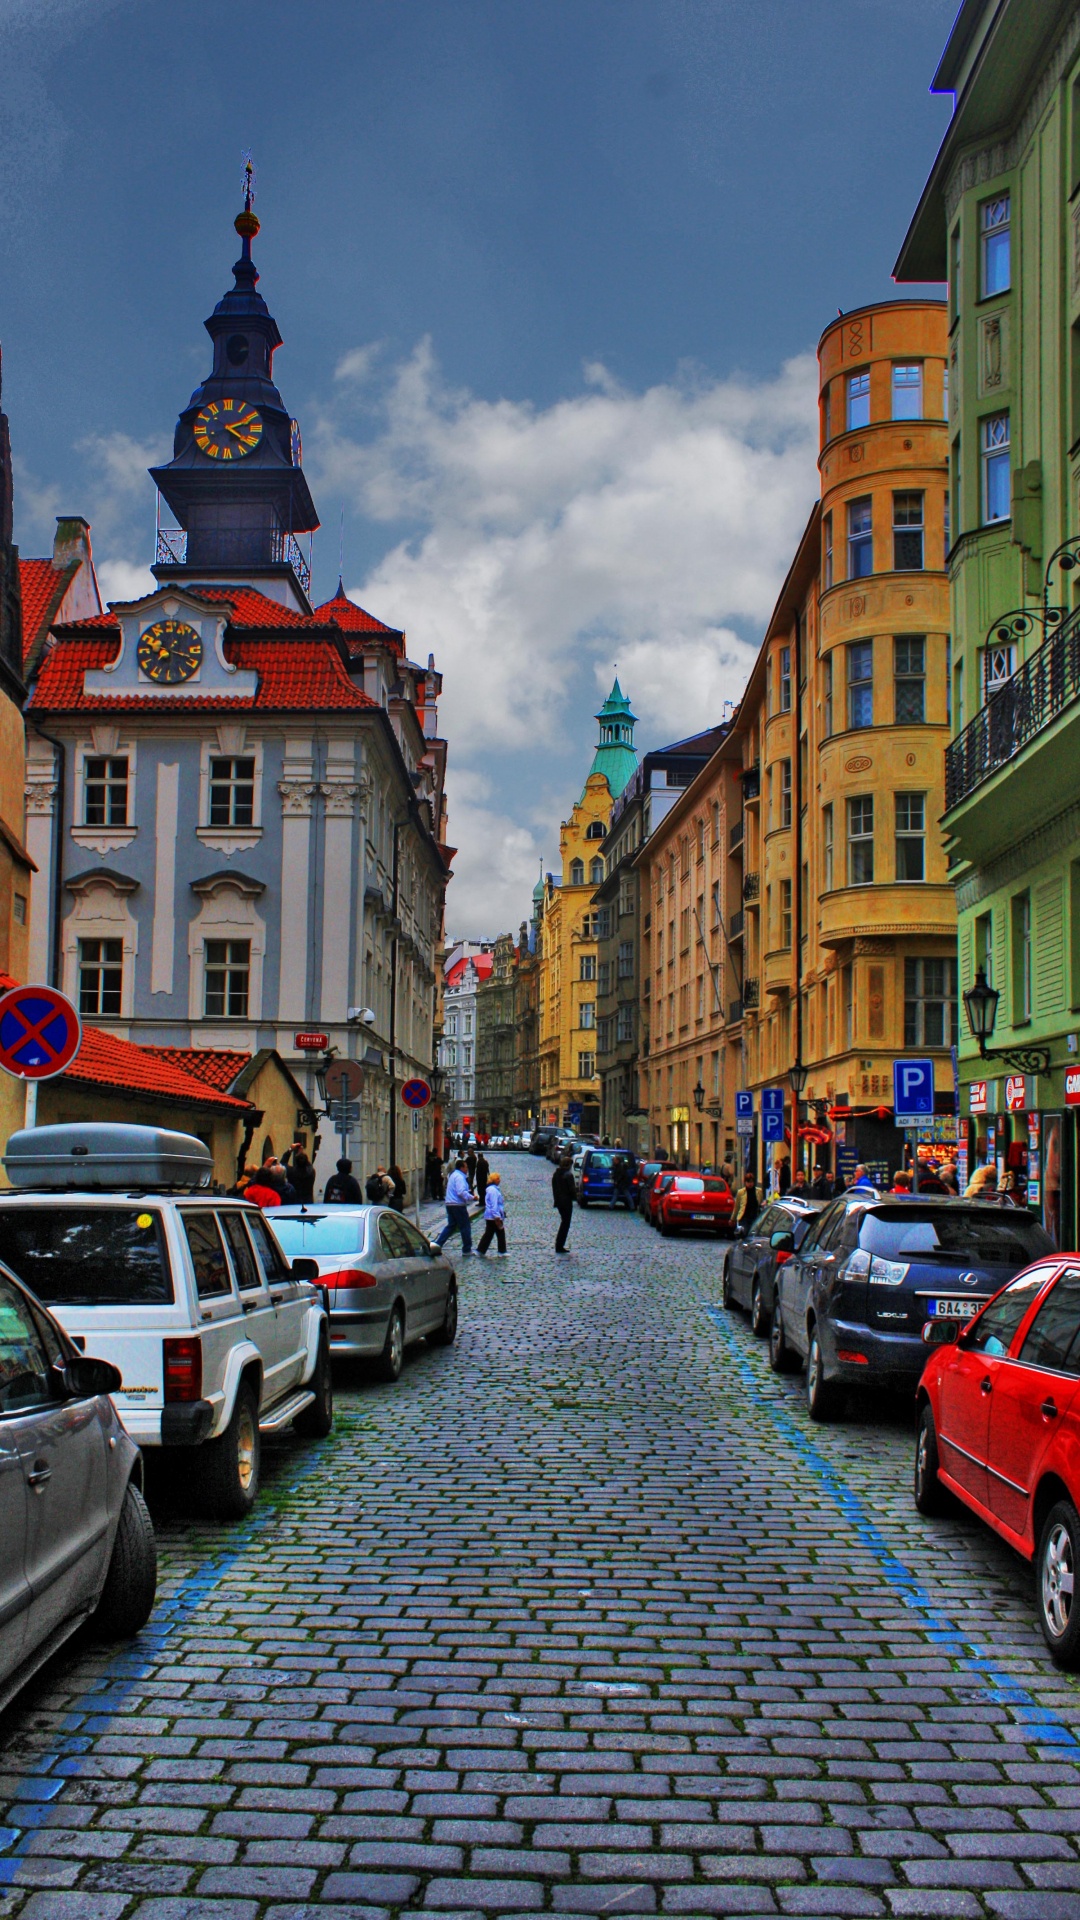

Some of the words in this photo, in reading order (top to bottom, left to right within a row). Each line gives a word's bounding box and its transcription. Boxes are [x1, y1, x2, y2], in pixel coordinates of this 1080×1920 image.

[903, 1068, 925, 1098] P
[739, 1095, 750, 1110] P
[767, 1115, 779, 1132] P
[877, 1311, 908, 1319] LEXUS
[938, 1302, 961, 1315] 6A4
